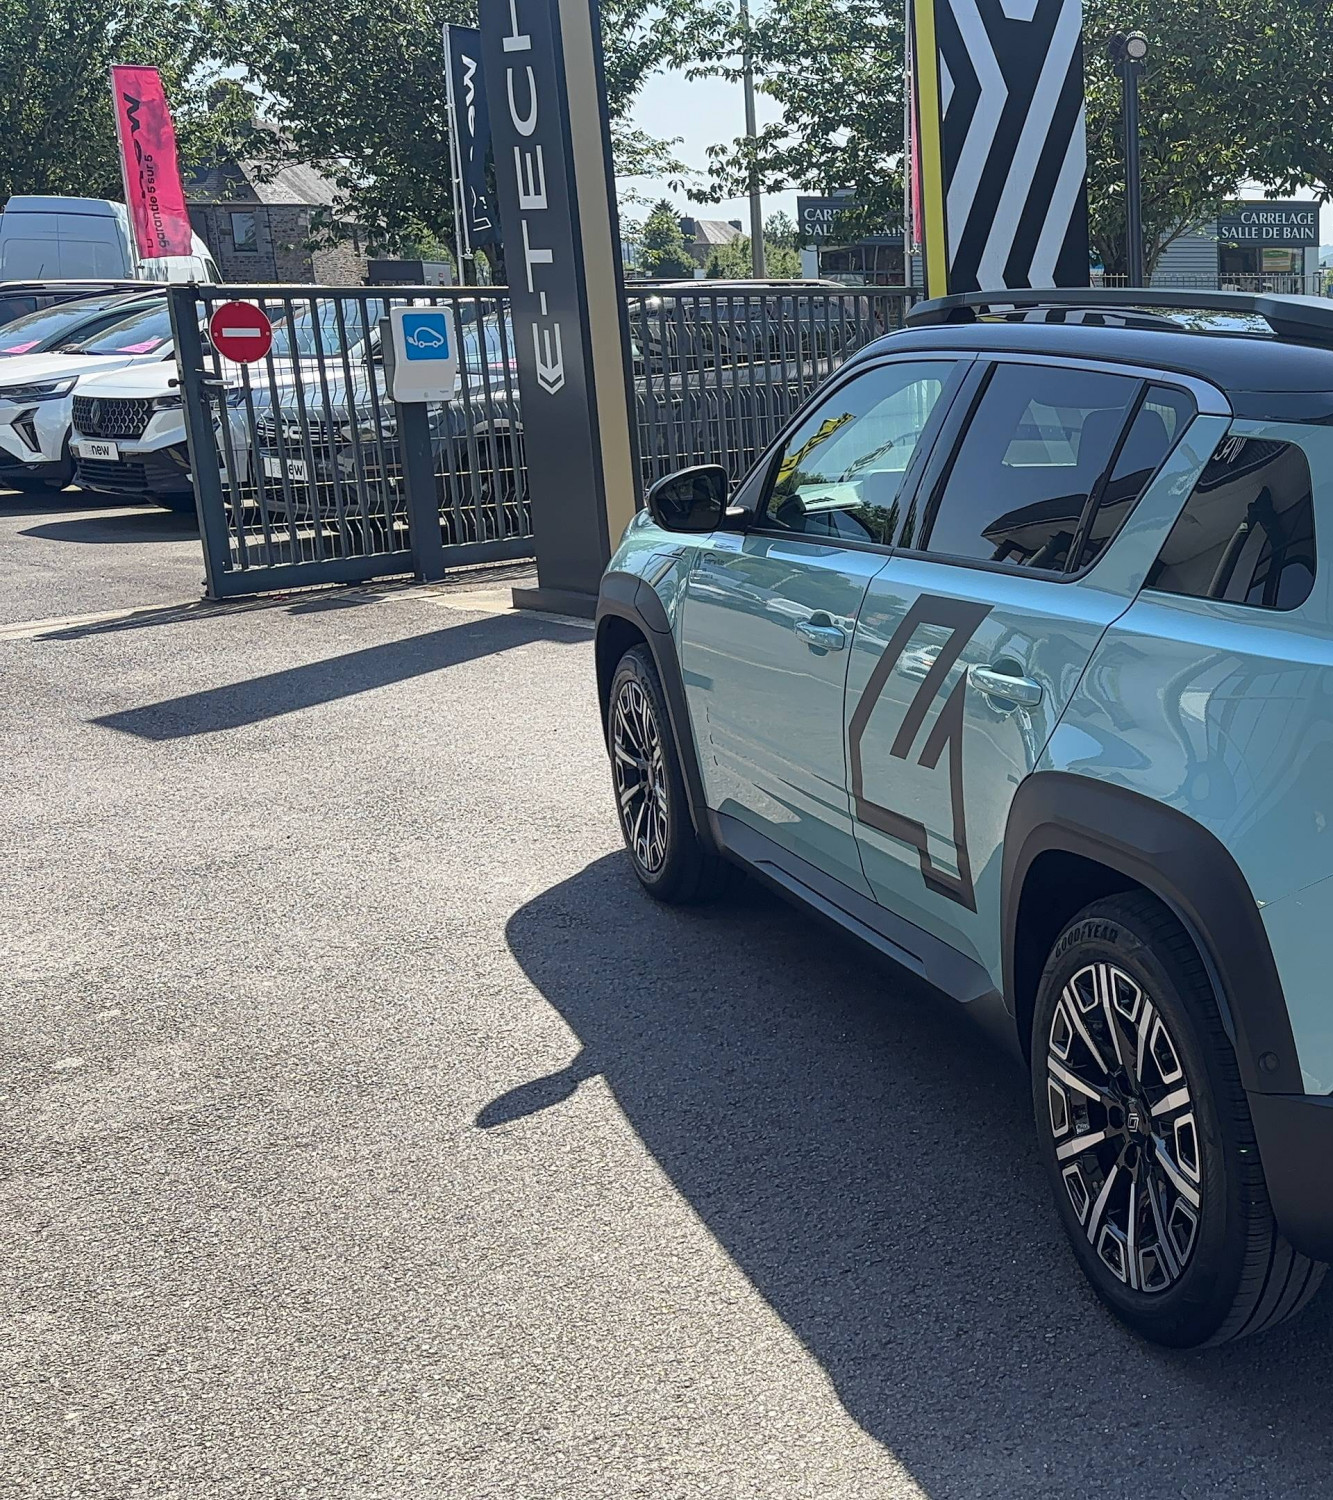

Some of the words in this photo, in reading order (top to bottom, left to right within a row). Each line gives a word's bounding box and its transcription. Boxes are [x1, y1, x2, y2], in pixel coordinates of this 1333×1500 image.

[144, 154, 153, 162] 5
[146, 164, 155, 184] sur
[147, 186, 156, 194] 5
[502, 0, 566, 395] E-TECH
[1241, 212, 1315, 225] CARRELAGE
[1222, 226, 1258, 239] SALLE
[1262, 227, 1280, 239] DE
[1283, 227, 1315, 239] BAIN
[1055, 921, 1119, 958] GOODYEAR
